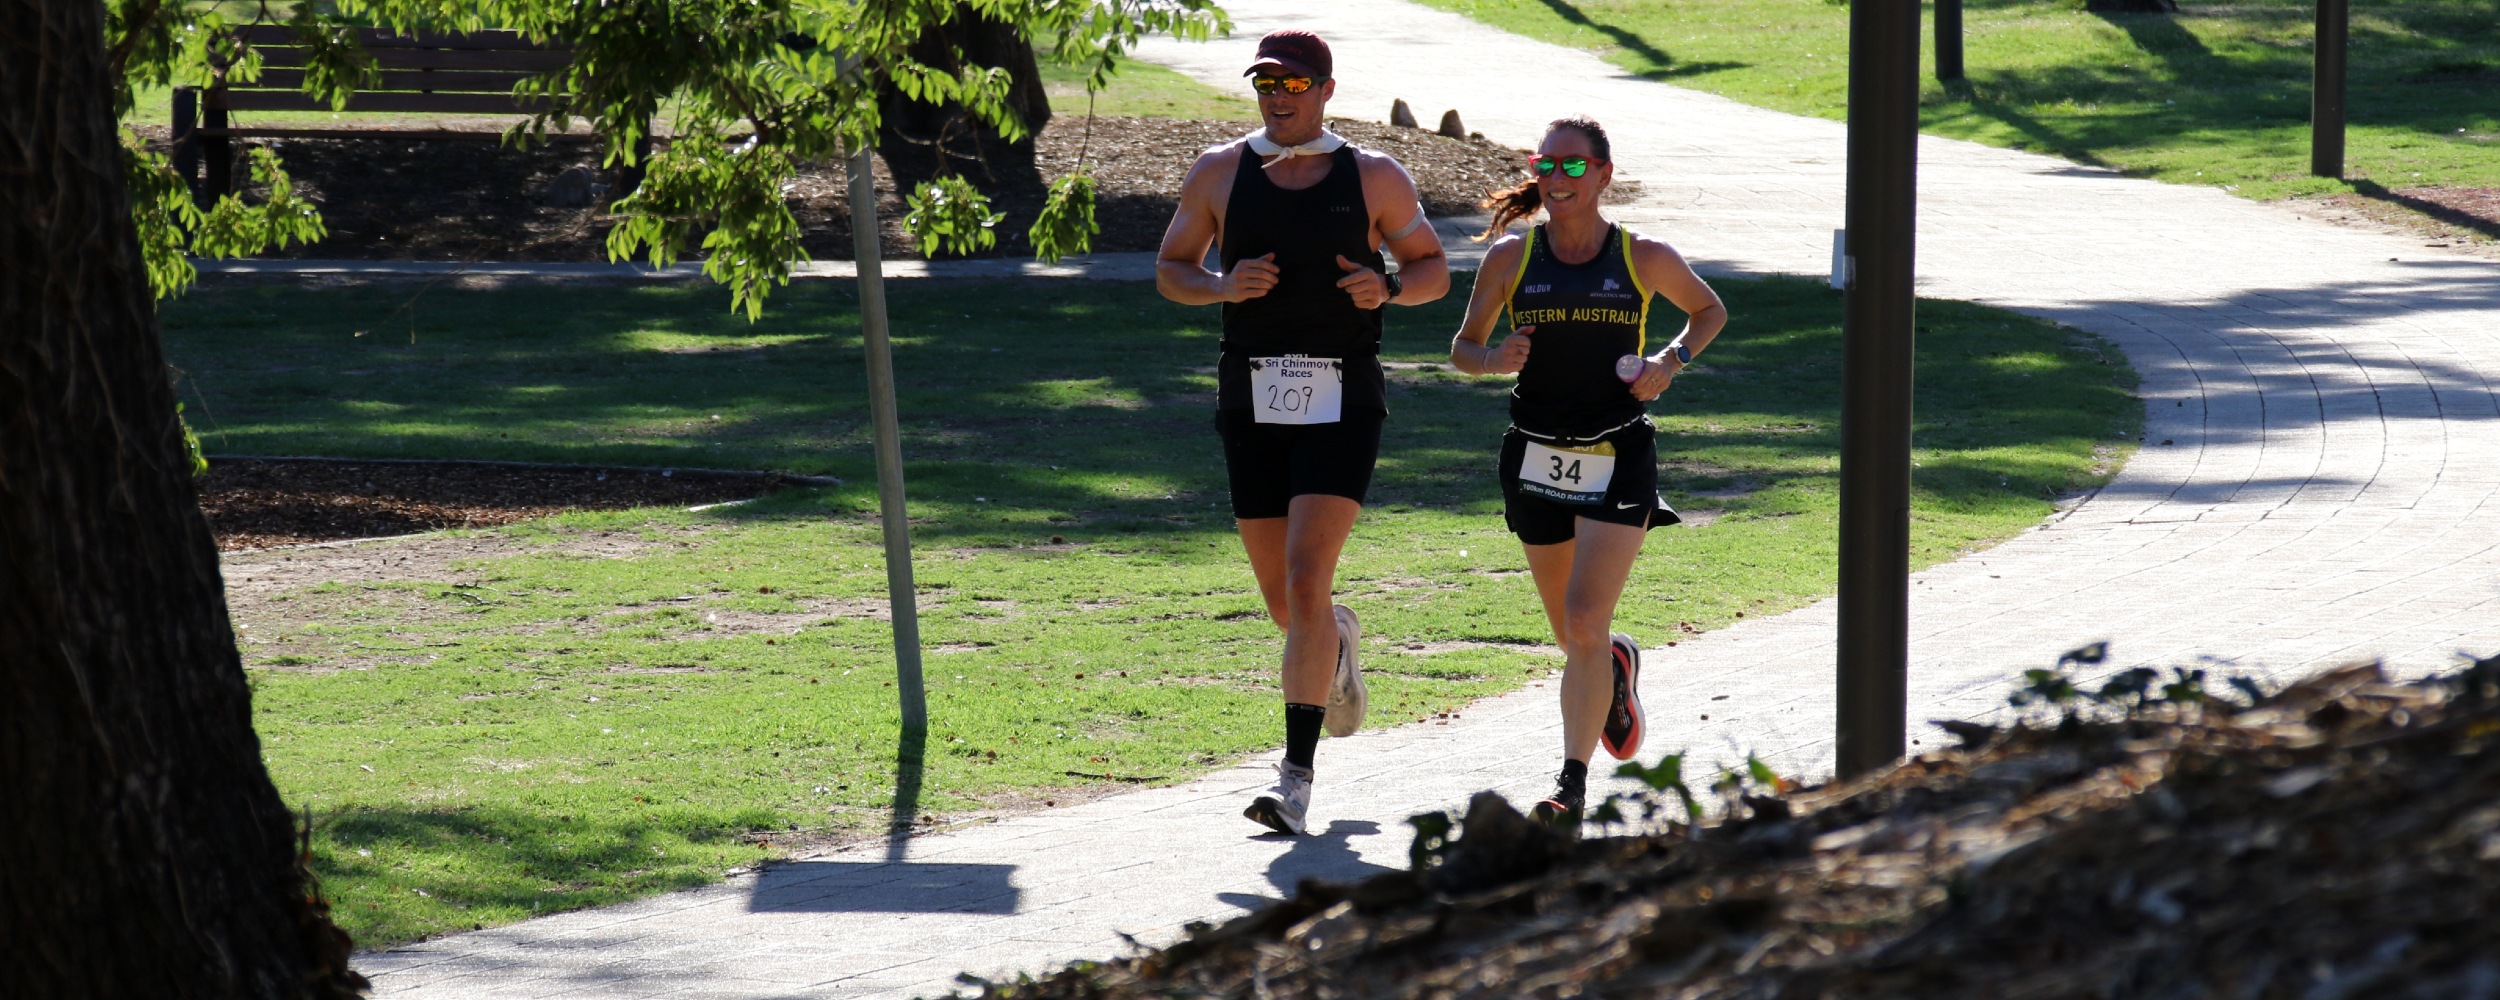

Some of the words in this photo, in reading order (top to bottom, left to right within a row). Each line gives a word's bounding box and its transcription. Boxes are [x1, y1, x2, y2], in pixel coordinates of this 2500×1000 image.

[1525, 284, 1552, 294] VALOUR
[1514, 308, 1567, 325] WESTERN
[1572, 308, 1639, 325] AUSTRALIA
[1265, 359, 1279, 368] Sri
[1282, 359, 1330, 371] Chinmoy
[1281, 368, 1313, 378] Races
[1268, 384, 1313, 415] 209
[1548, 455, 1582, 485] 34
[1523, 483, 1544, 494] 100km
[1545, 489, 1566, 499] ROAD
